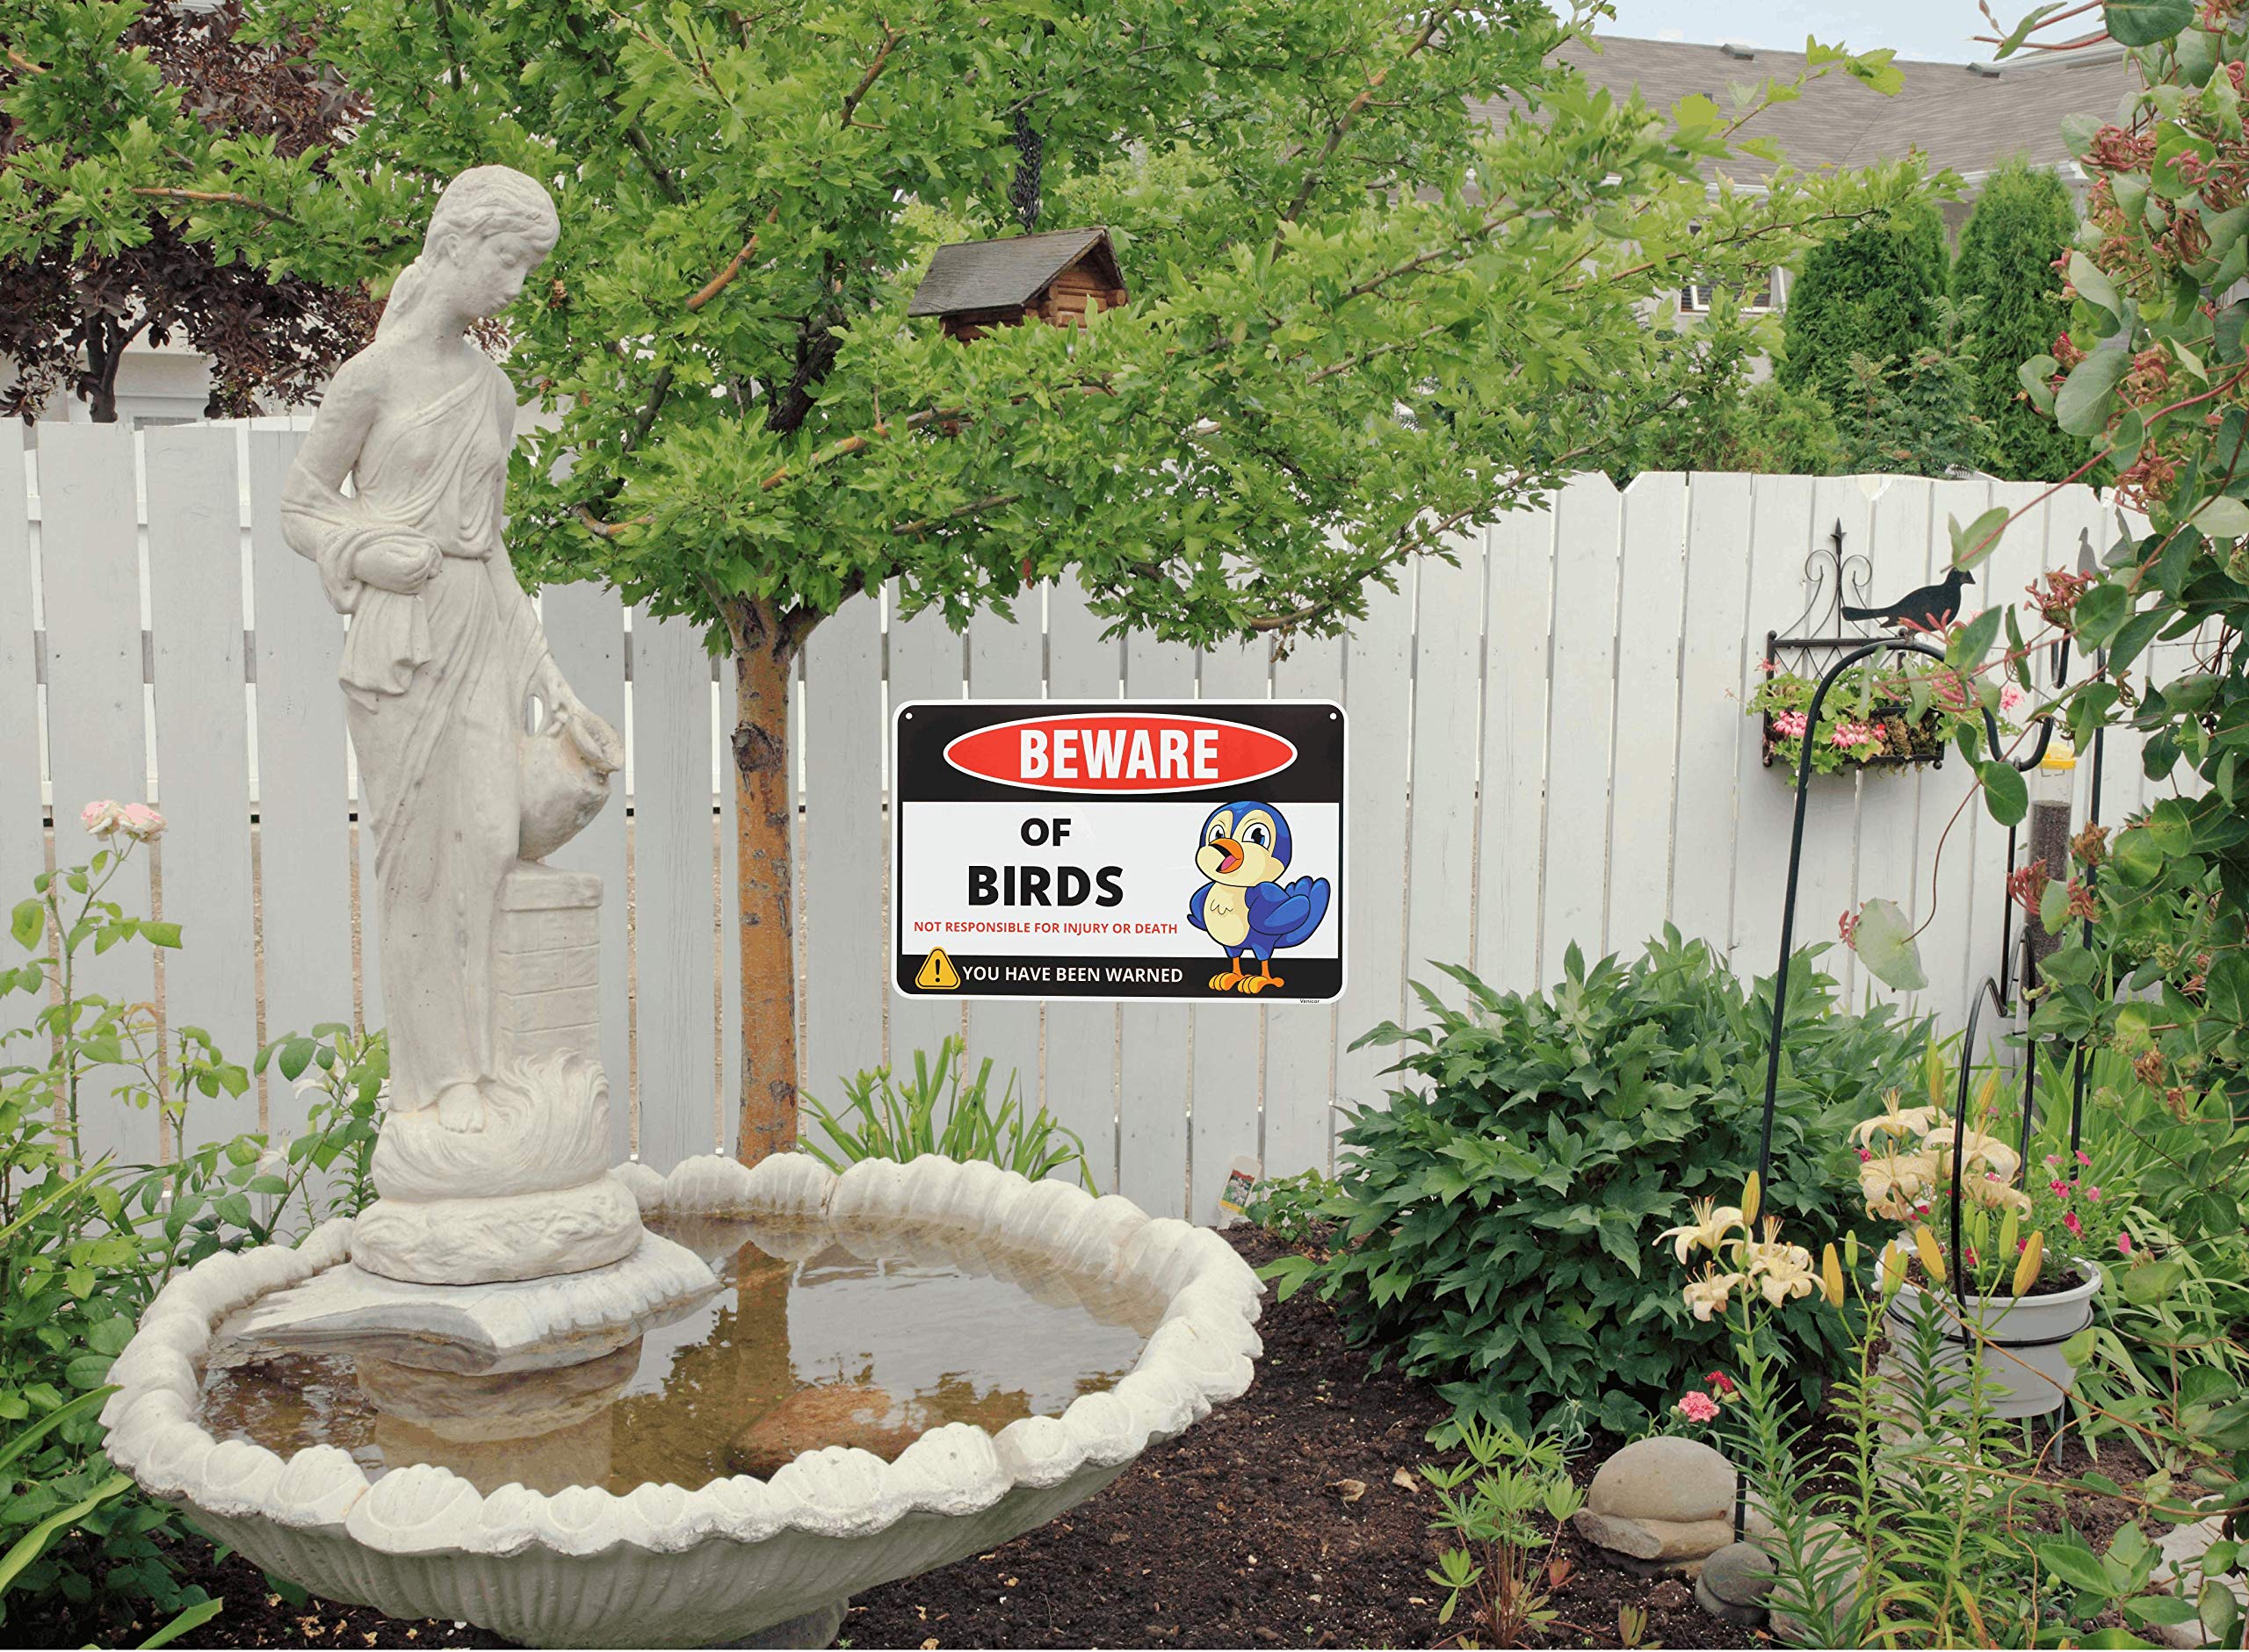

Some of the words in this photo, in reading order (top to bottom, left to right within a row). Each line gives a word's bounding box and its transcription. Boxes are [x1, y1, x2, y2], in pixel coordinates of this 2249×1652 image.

[1020, 729, 1219, 779] BEWARE
[1020, 818, 1072, 847] OF
[968, 865, 1124, 907] BIRDS
[914, 921, 942, 933] NOT
[944, 921, 1030, 934] RESPONSIBLE
[1034, 922, 1060, 934] FOR
[1063, 922, 1110, 935] INJURY
[1112, 923, 1132, 934] OR
[1134, 923, 1178, 934] DEATH
[962, 966, 999, 981] YOU
[1005, 966, 1051, 981] HAVE
[1056, 967, 1100, 982] BEEN
[1105, 967, 1183, 983] WARNED
